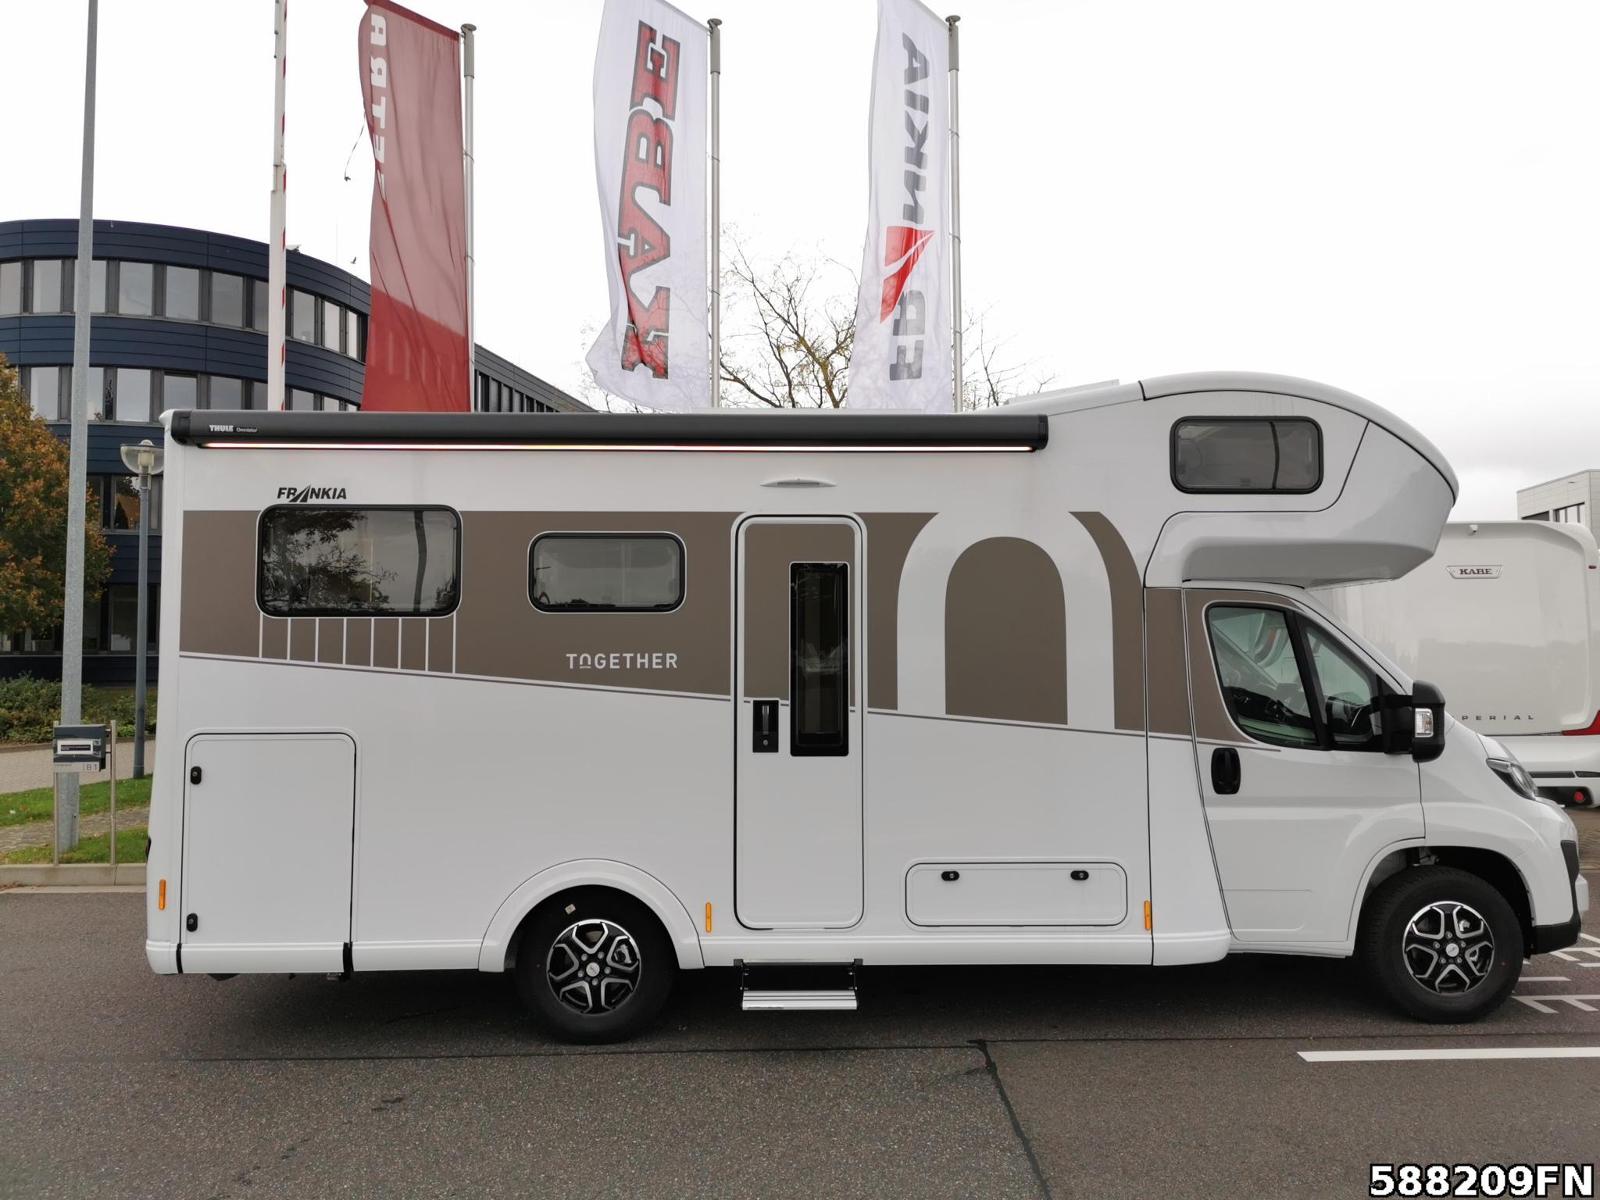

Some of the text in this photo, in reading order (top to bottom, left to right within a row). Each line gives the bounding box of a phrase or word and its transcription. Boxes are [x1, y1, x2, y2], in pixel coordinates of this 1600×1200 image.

[209, 424, 234, 433] THULE
[277, 484, 347, 503] FRANKIA
[566, 653, 678, 669] TOGETHER
